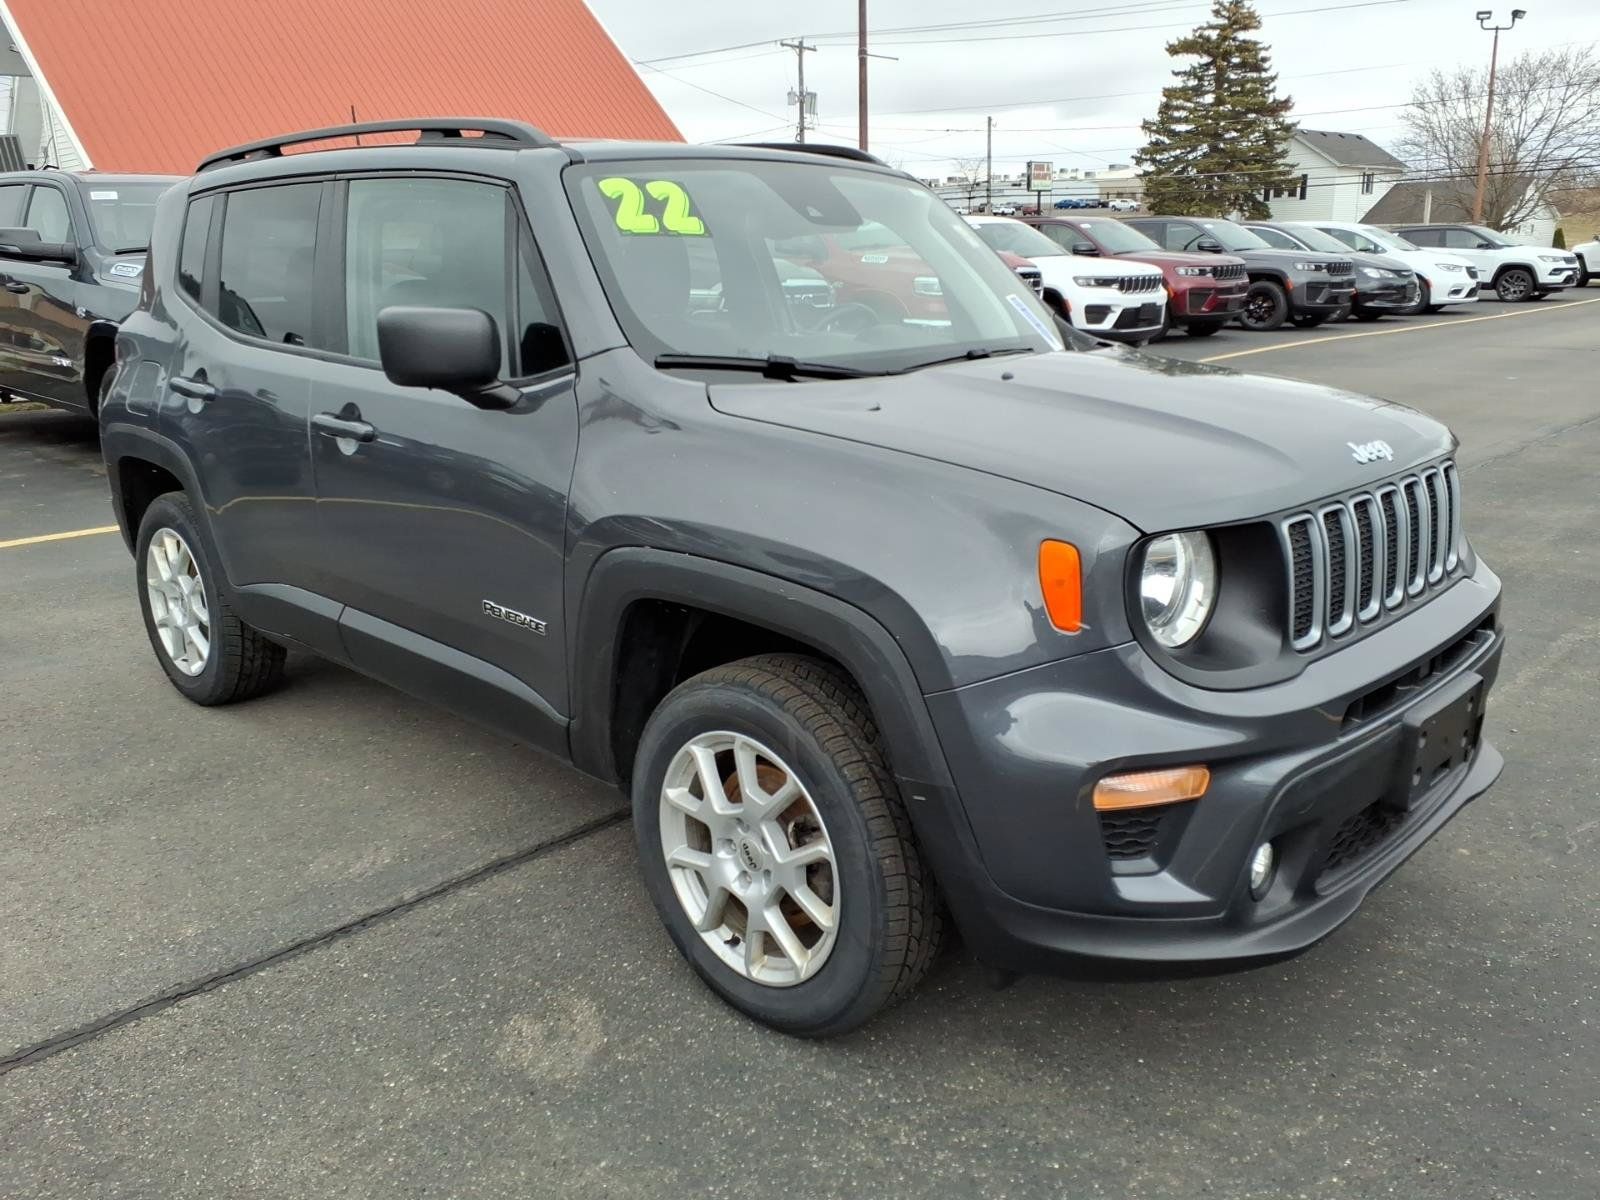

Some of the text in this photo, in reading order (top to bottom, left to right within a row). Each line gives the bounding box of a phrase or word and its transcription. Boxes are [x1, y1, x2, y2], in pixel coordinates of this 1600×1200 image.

[598, 177, 704, 235] 22
[1346, 440, 1393, 465] Jeep
[482, 599, 548, 635] RENEGADE
[742, 842, 758, 869] Jeep
